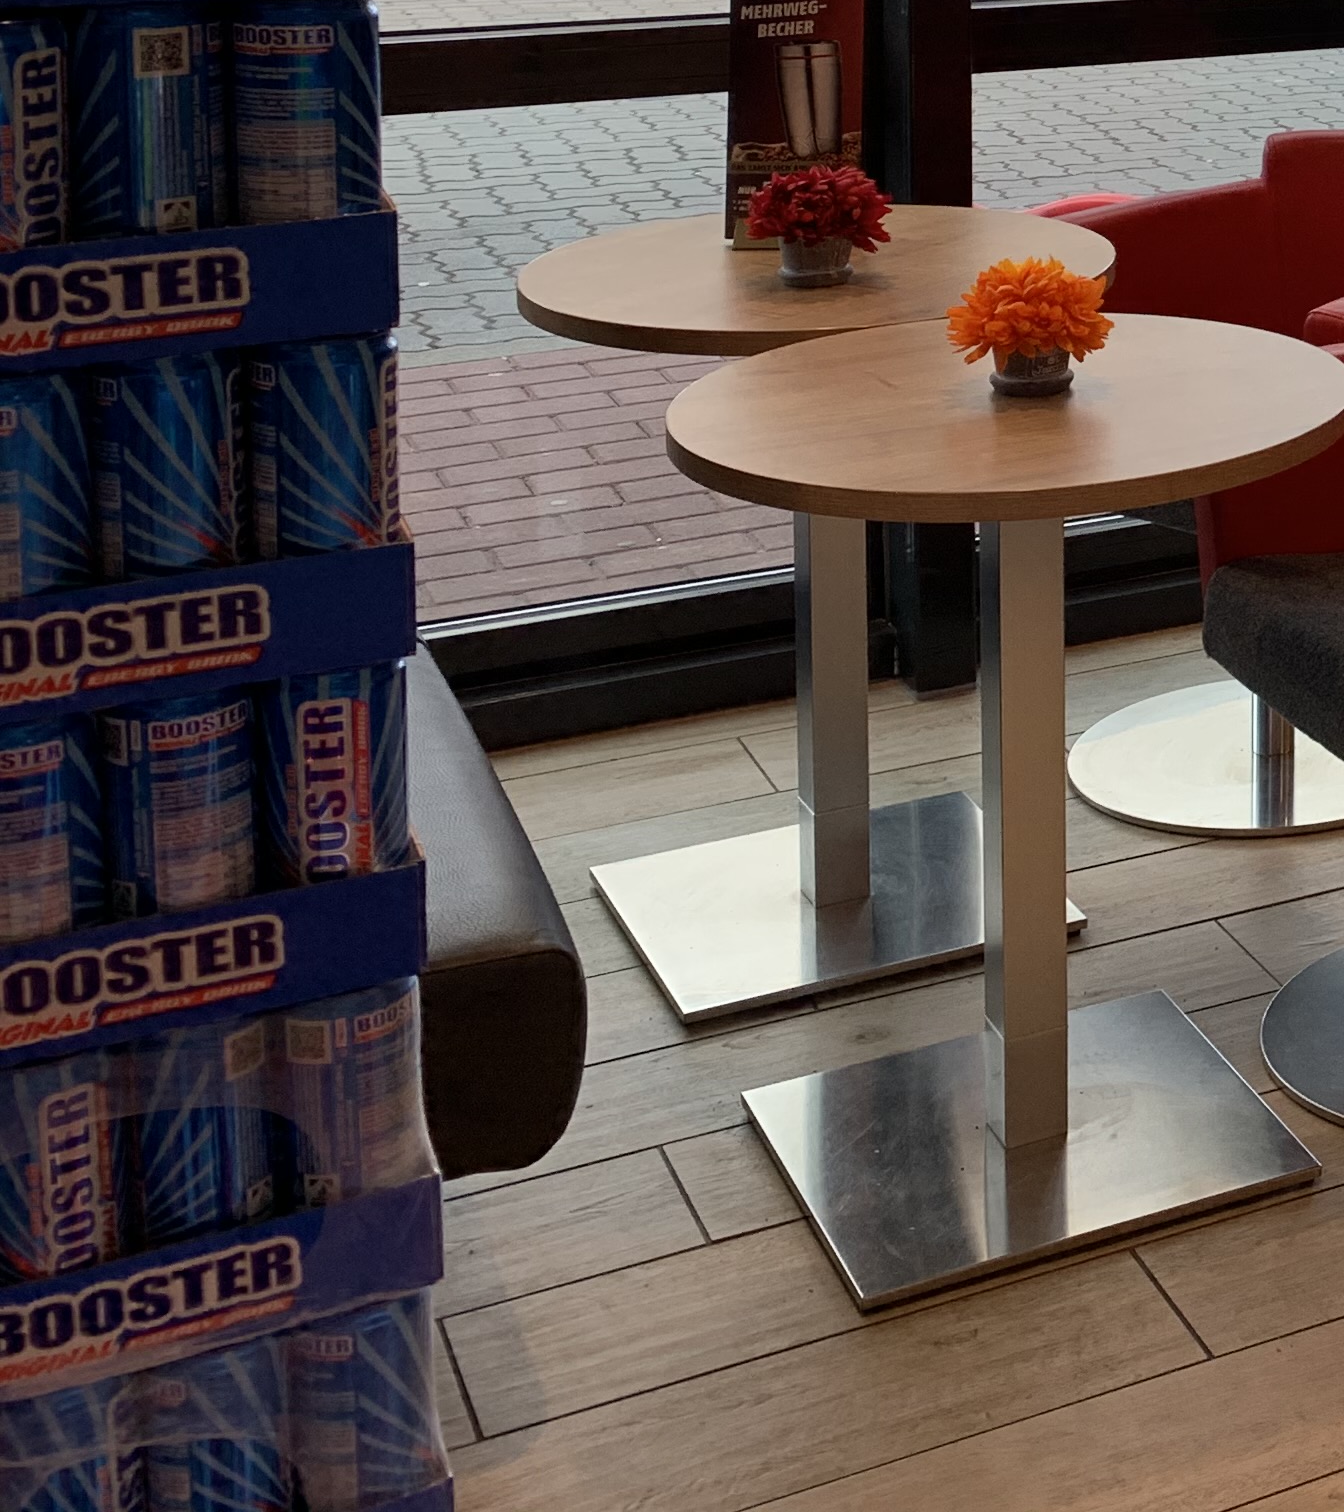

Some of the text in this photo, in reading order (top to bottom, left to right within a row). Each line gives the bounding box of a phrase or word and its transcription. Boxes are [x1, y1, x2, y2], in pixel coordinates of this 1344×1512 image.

[740, 0, 828, 21] MEHRWEG-
[757, 20, 815, 39] BECHER
[21, 53, 62, 248] OOSTER
[0, 255, 242, 324] OSTER
[165, 315, 236, 335] DRINK
[0, 590, 263, 675] OOSTER
[151, 701, 248, 740] BOOSTER
[0, 743, 62, 770] STER
[303, 705, 349, 884] OOSTER
[3, 921, 276, 1016] OOSTER
[47, 1091, 99, 1275] OOSTER
